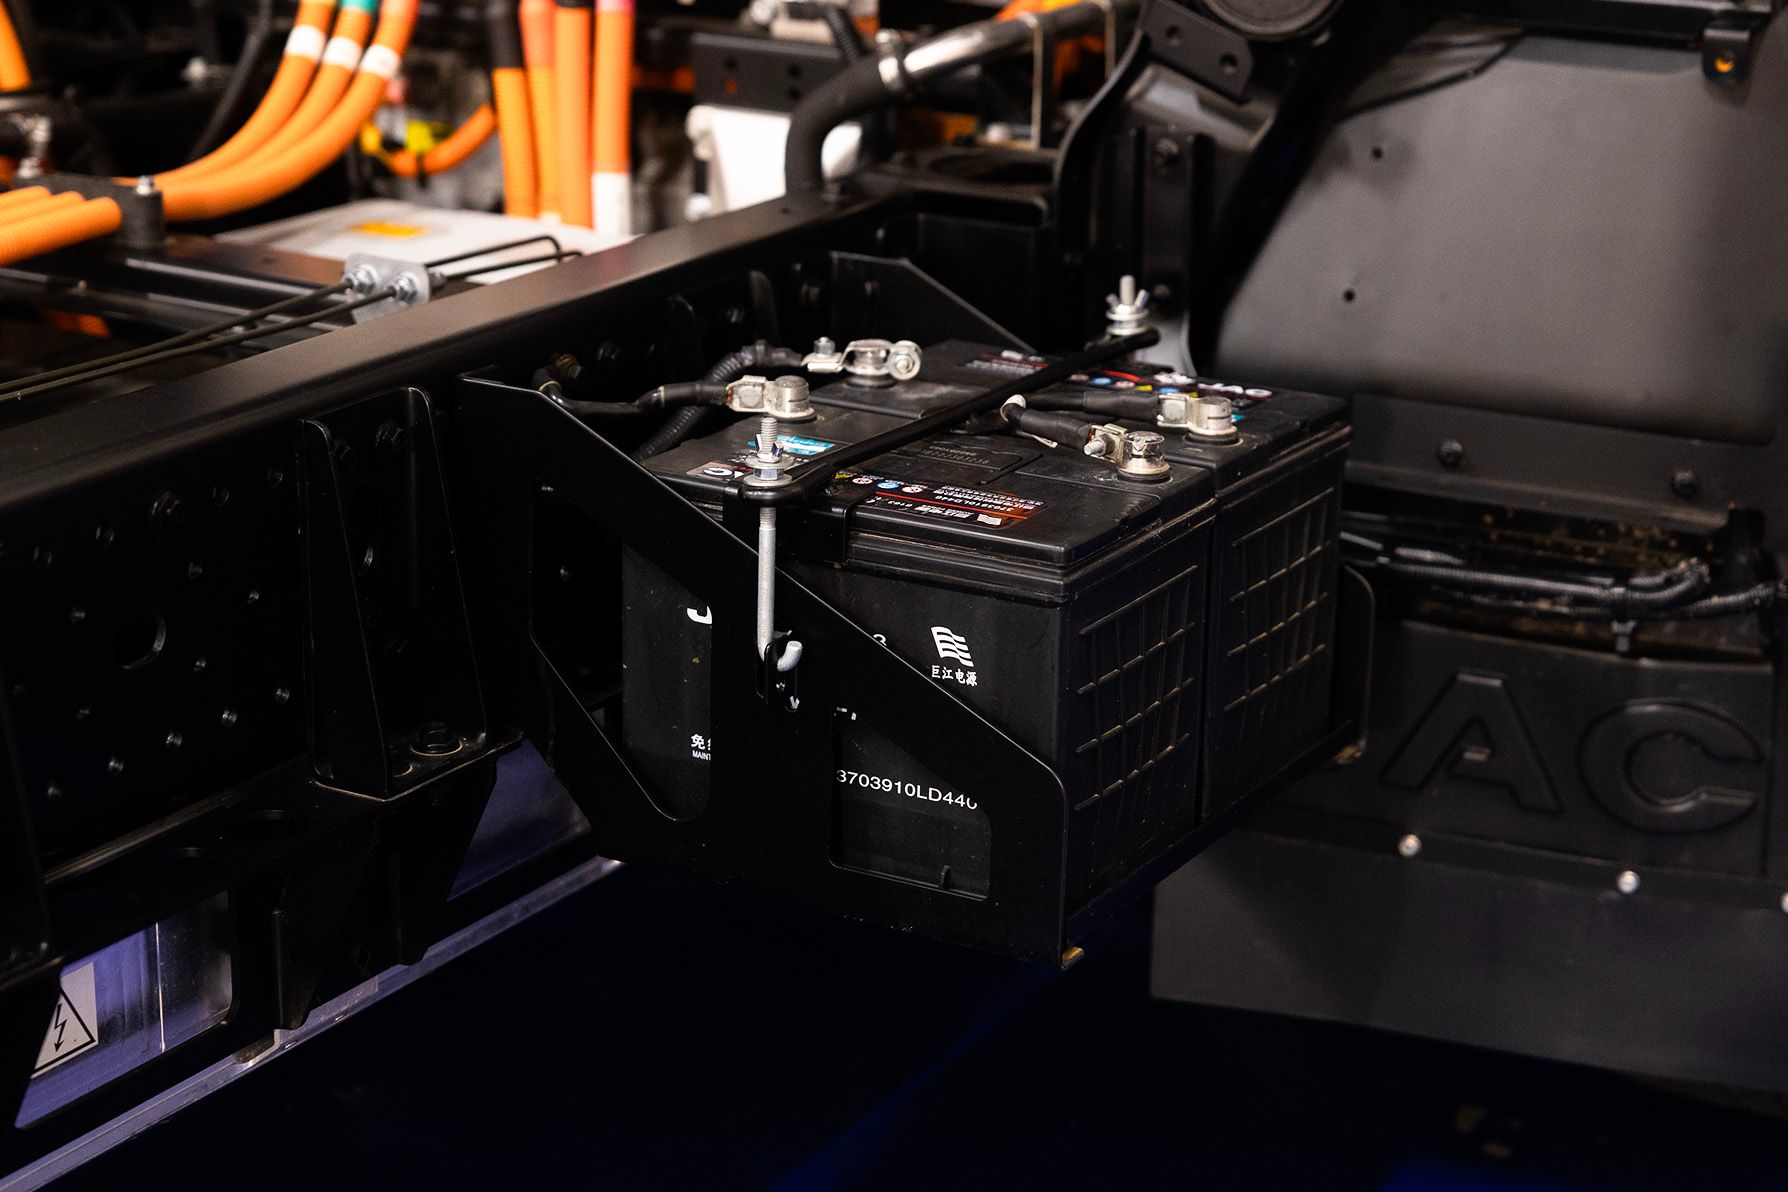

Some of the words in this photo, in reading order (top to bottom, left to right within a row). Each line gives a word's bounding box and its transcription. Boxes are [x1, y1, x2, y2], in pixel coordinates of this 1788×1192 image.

[931, 664, 978, 687] 巨江电源
[691, 733, 711, 750] 免
